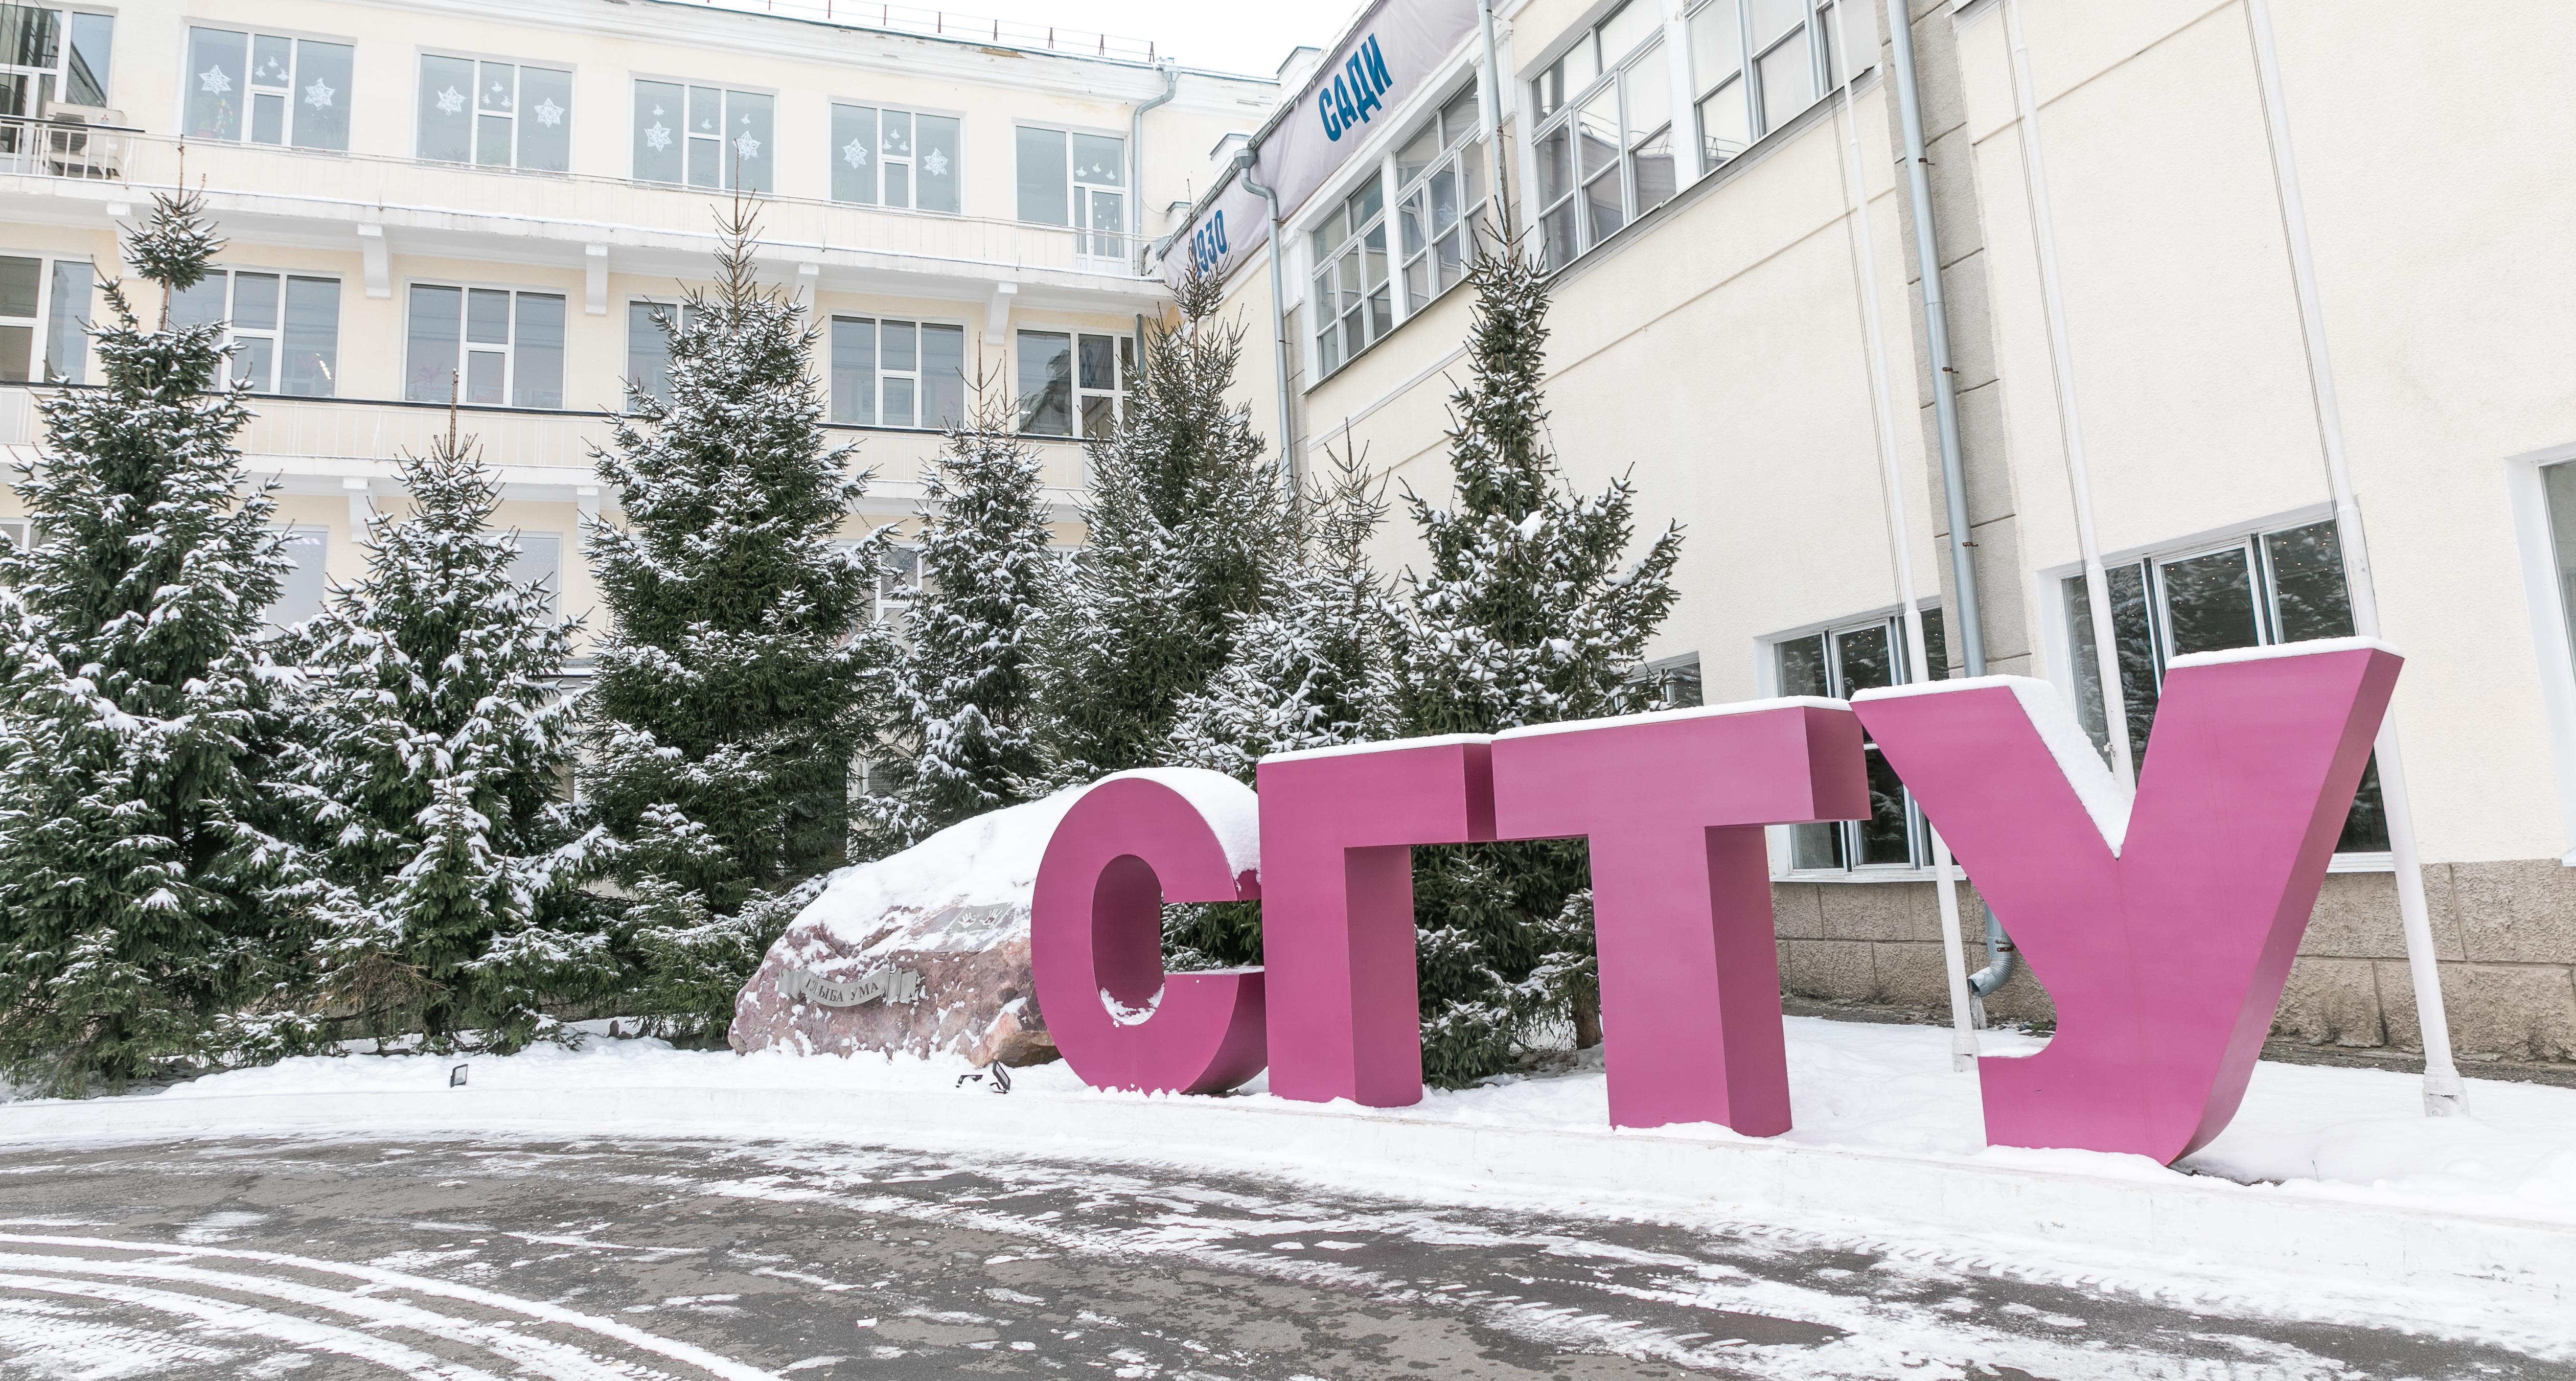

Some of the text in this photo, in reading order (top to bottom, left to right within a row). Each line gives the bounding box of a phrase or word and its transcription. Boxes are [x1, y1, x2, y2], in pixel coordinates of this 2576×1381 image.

[1191, 33, 1393, 279] 1930 САДИ
[850, 980, 879, 1001] УМА
[1031, 645, 2403, 1167] СГТУ
